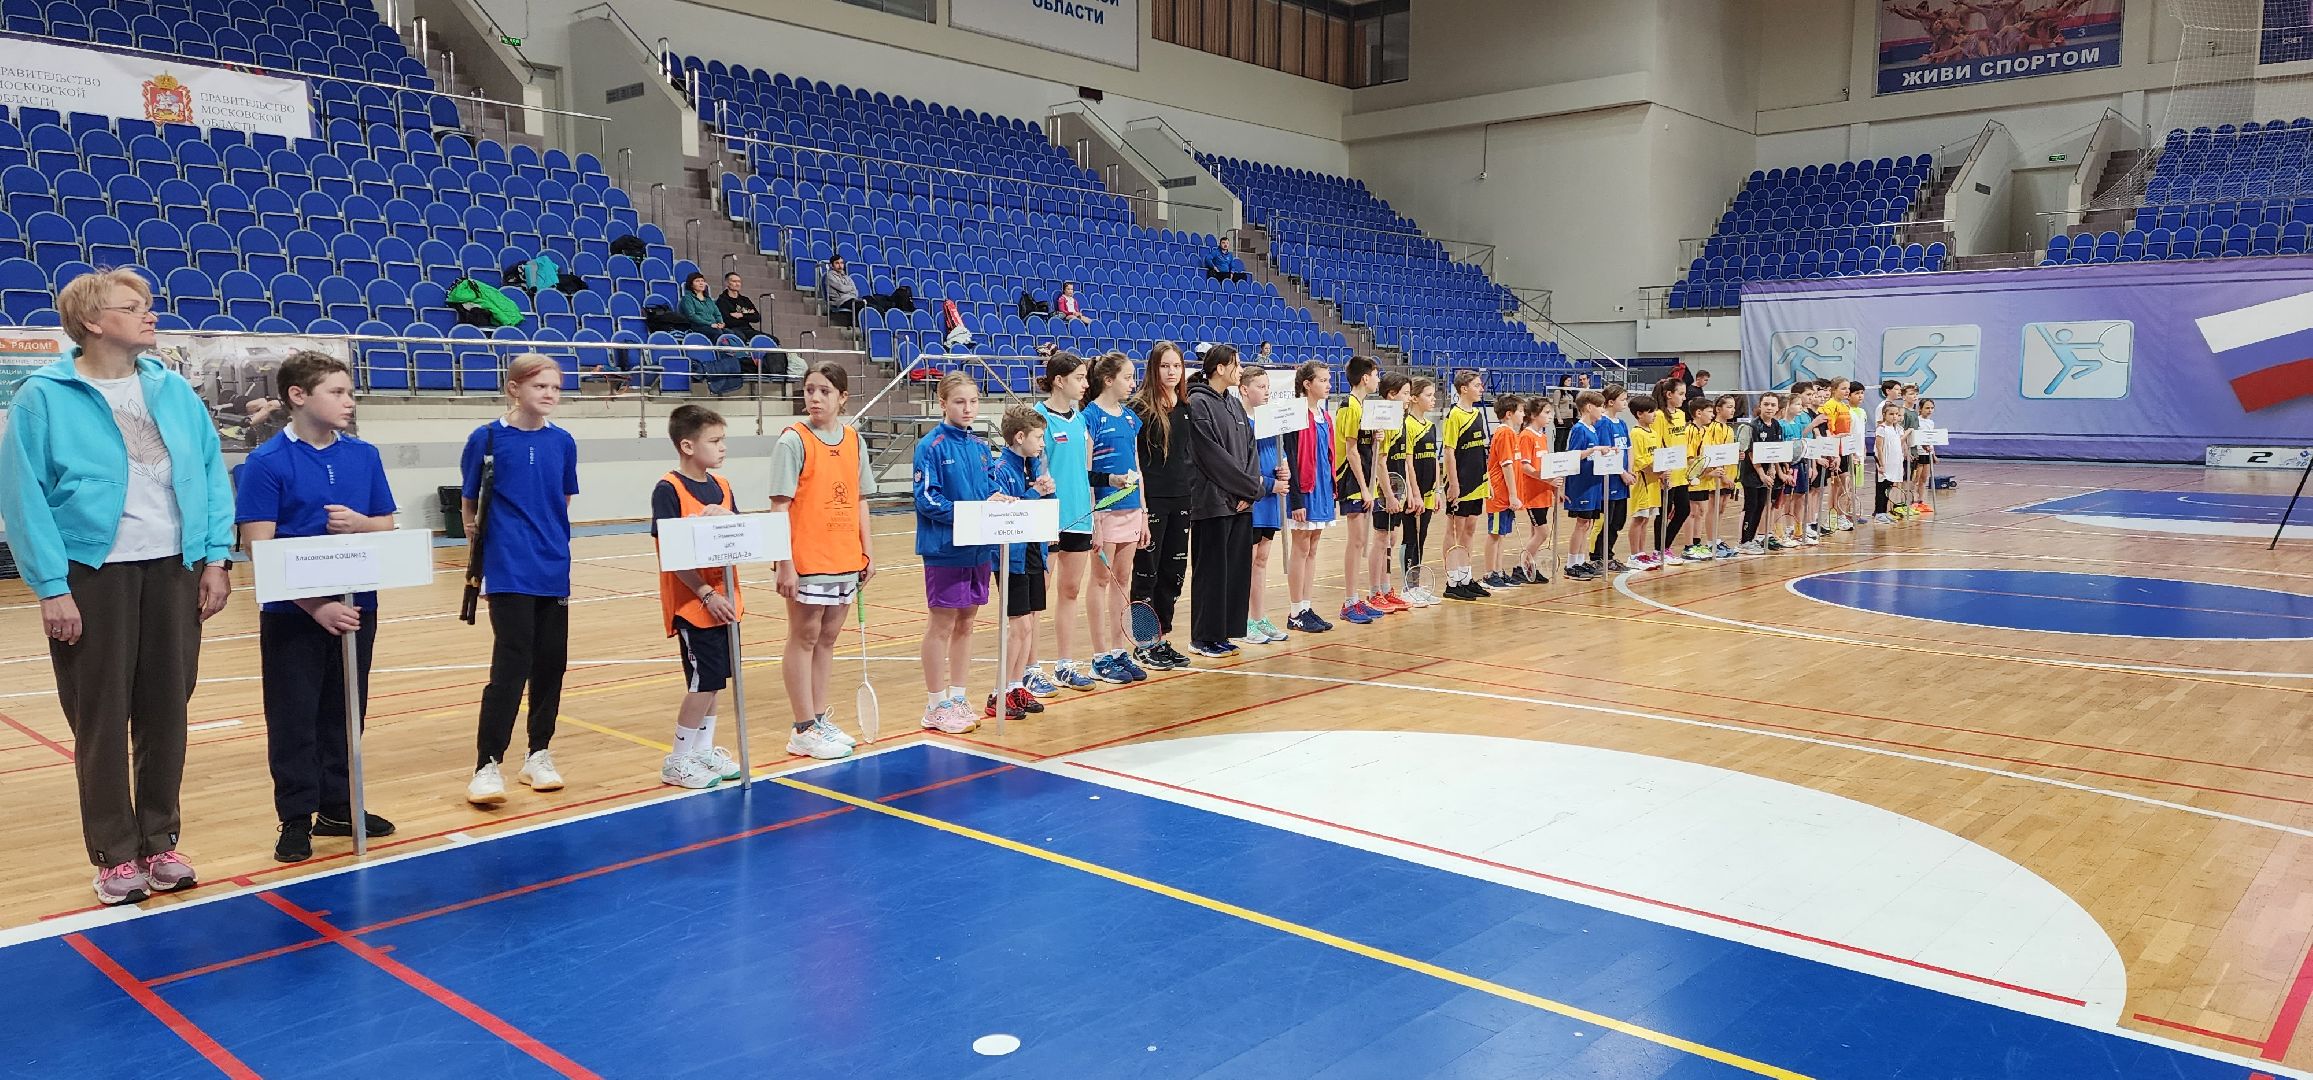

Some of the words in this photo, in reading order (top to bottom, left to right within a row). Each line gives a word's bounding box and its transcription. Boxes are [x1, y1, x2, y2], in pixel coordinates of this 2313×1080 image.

[0, 66, 101, 87] РАВИТЕЛЬСТВО
[1902, 64, 1972, 87] ЖИВИ
[1979, 47, 2100, 77] СПОРТОМ
[200, 92, 296, 113] ПРАВИТЕЛЬСТВО
[201, 105, 283, 124] МОСКОВСКОЙ
[202, 118, 257, 132] ОБЛАСТИ
[11, 341, 52, 350] РЯДОМ!
[2247, 451, 2274, 464] 2
